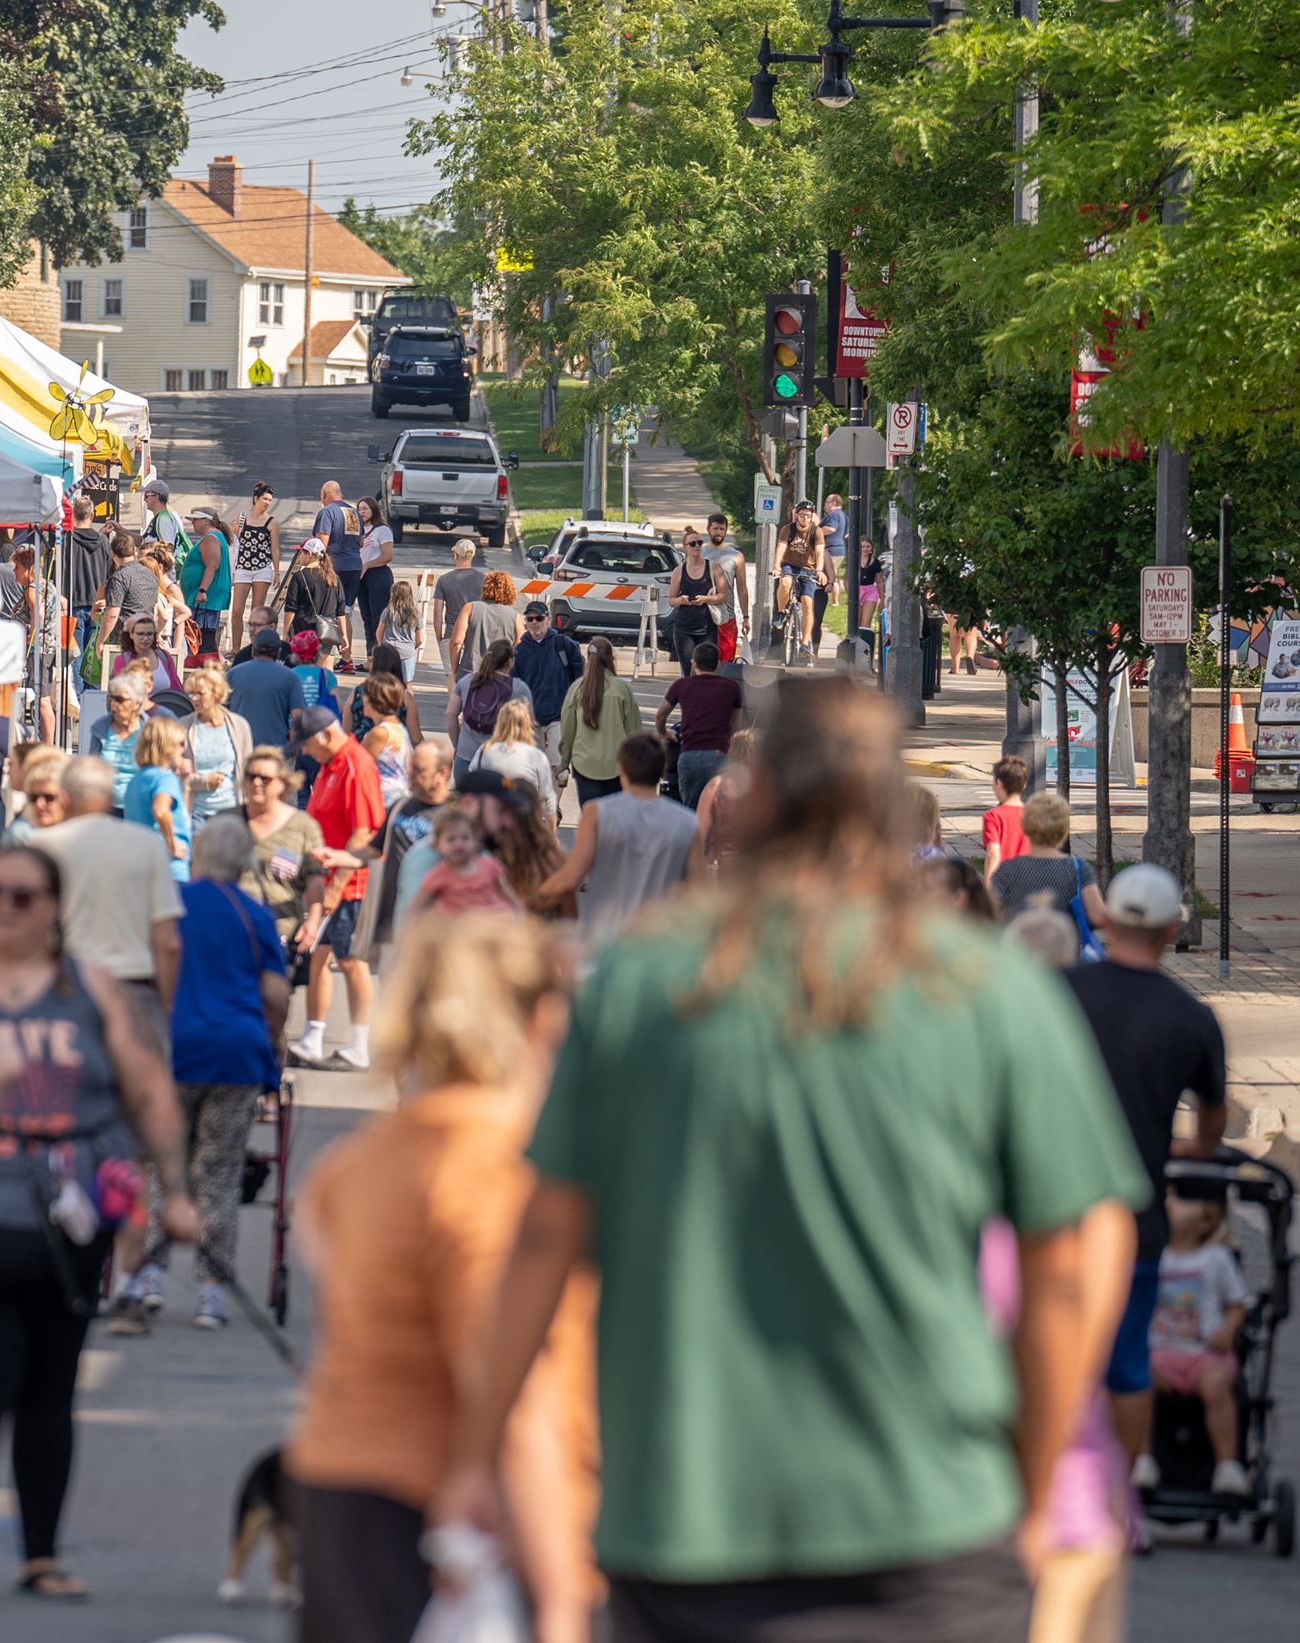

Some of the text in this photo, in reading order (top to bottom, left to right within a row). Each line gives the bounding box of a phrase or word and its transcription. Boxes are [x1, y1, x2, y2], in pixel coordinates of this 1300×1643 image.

[100, 479, 117, 492] Cuds
[1157, 572, 1175, 586] NO
[1145, 588, 1187, 602] PARKING
[1147, 603, 1184, 612] SATURDAYS
[1153, 621, 1167, 629] MAY
[1146, 629, 1177, 638] OCTOBER
